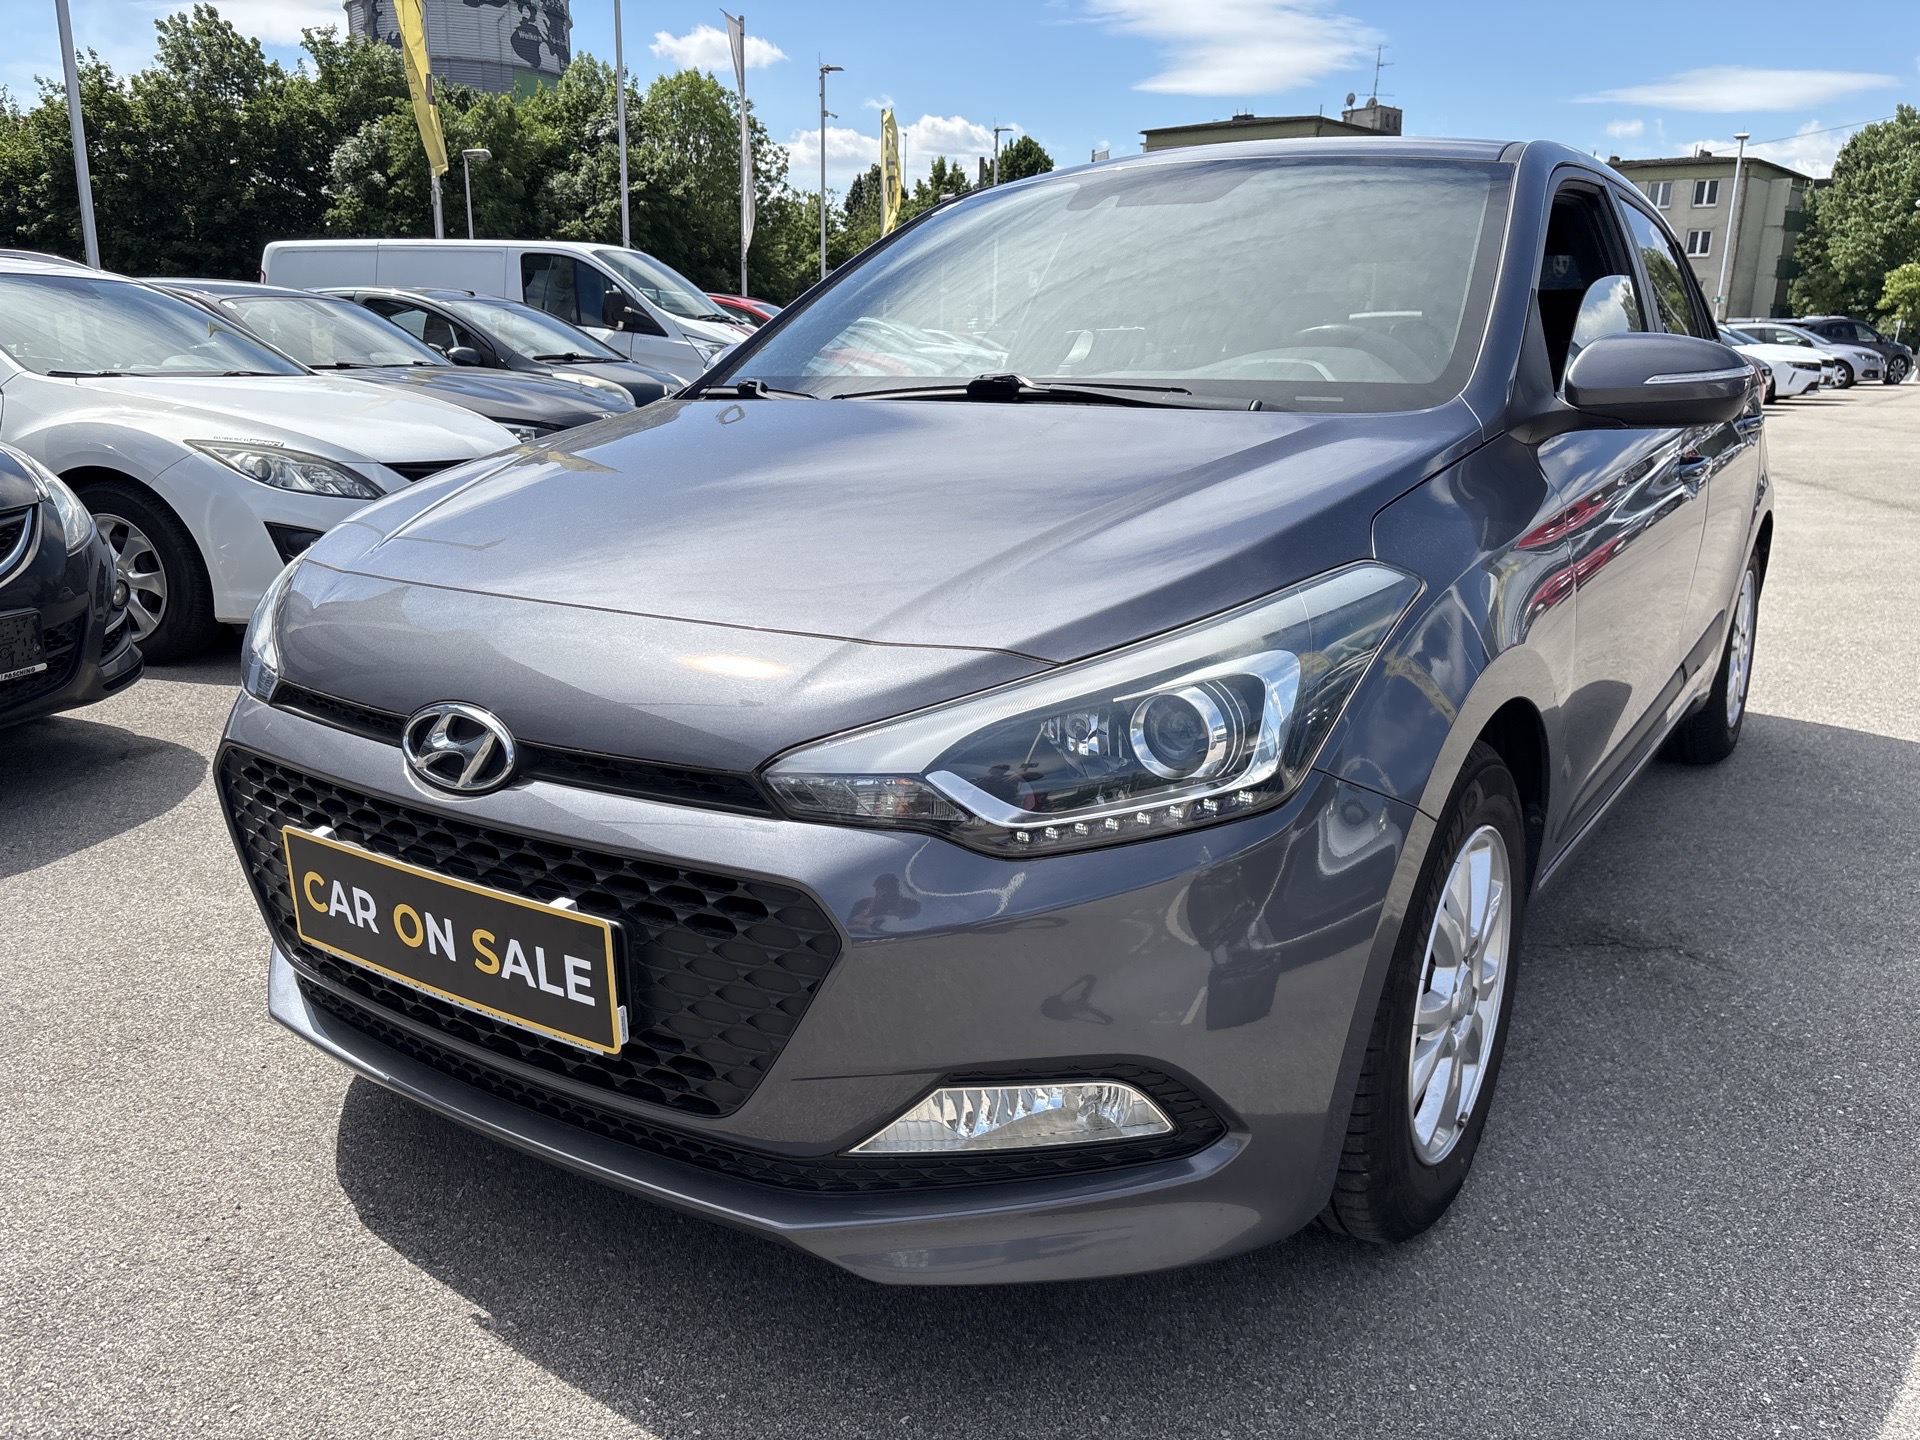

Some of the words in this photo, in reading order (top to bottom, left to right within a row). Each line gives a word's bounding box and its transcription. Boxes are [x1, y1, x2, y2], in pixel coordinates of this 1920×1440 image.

[4, 666, 36, 680] PASCHING
[303, 871, 380, 934] CAR
[393, 903, 457, 962] ON
[471, 928, 596, 1007] SALE
[1408, 810, 1466, 986] MICHELIN
